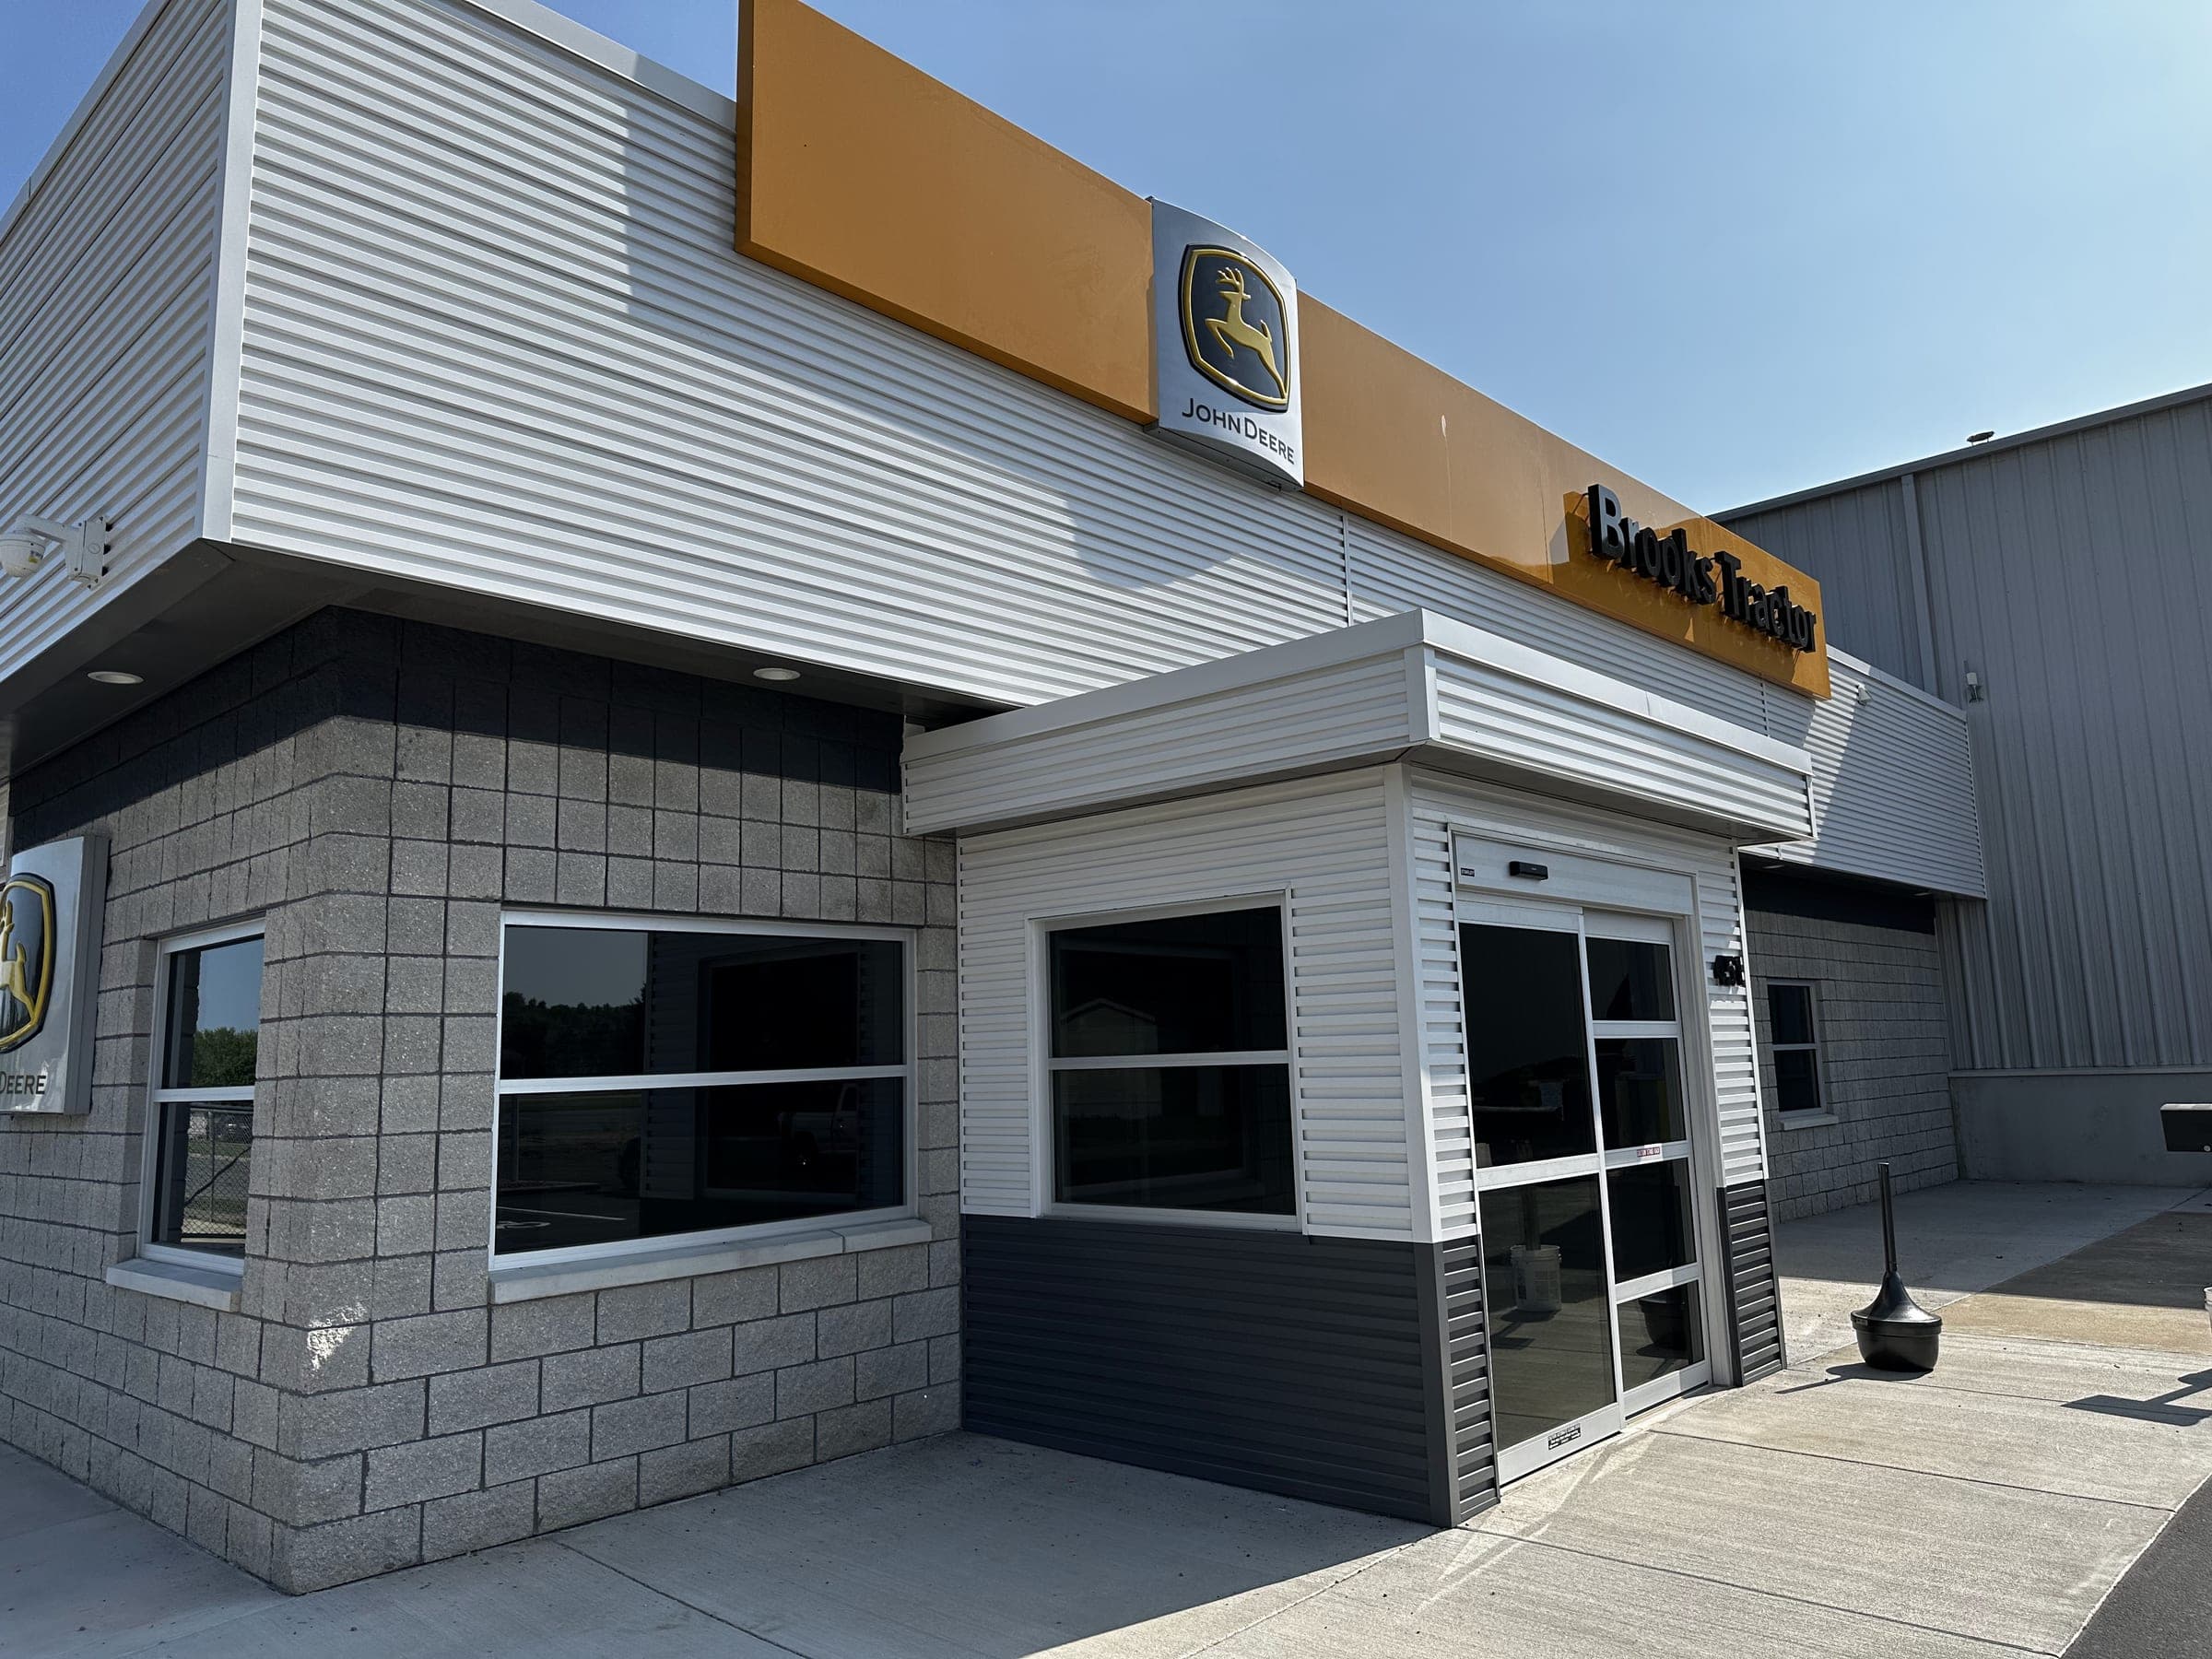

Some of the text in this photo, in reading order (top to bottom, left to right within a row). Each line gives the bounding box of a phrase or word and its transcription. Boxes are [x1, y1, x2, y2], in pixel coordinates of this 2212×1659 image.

[1182, 397, 1295, 465] JOHN DEERE
[1587, 484, 1817, 653] Brooks Tractor
[0, 1071, 47, 1095] DEERE
